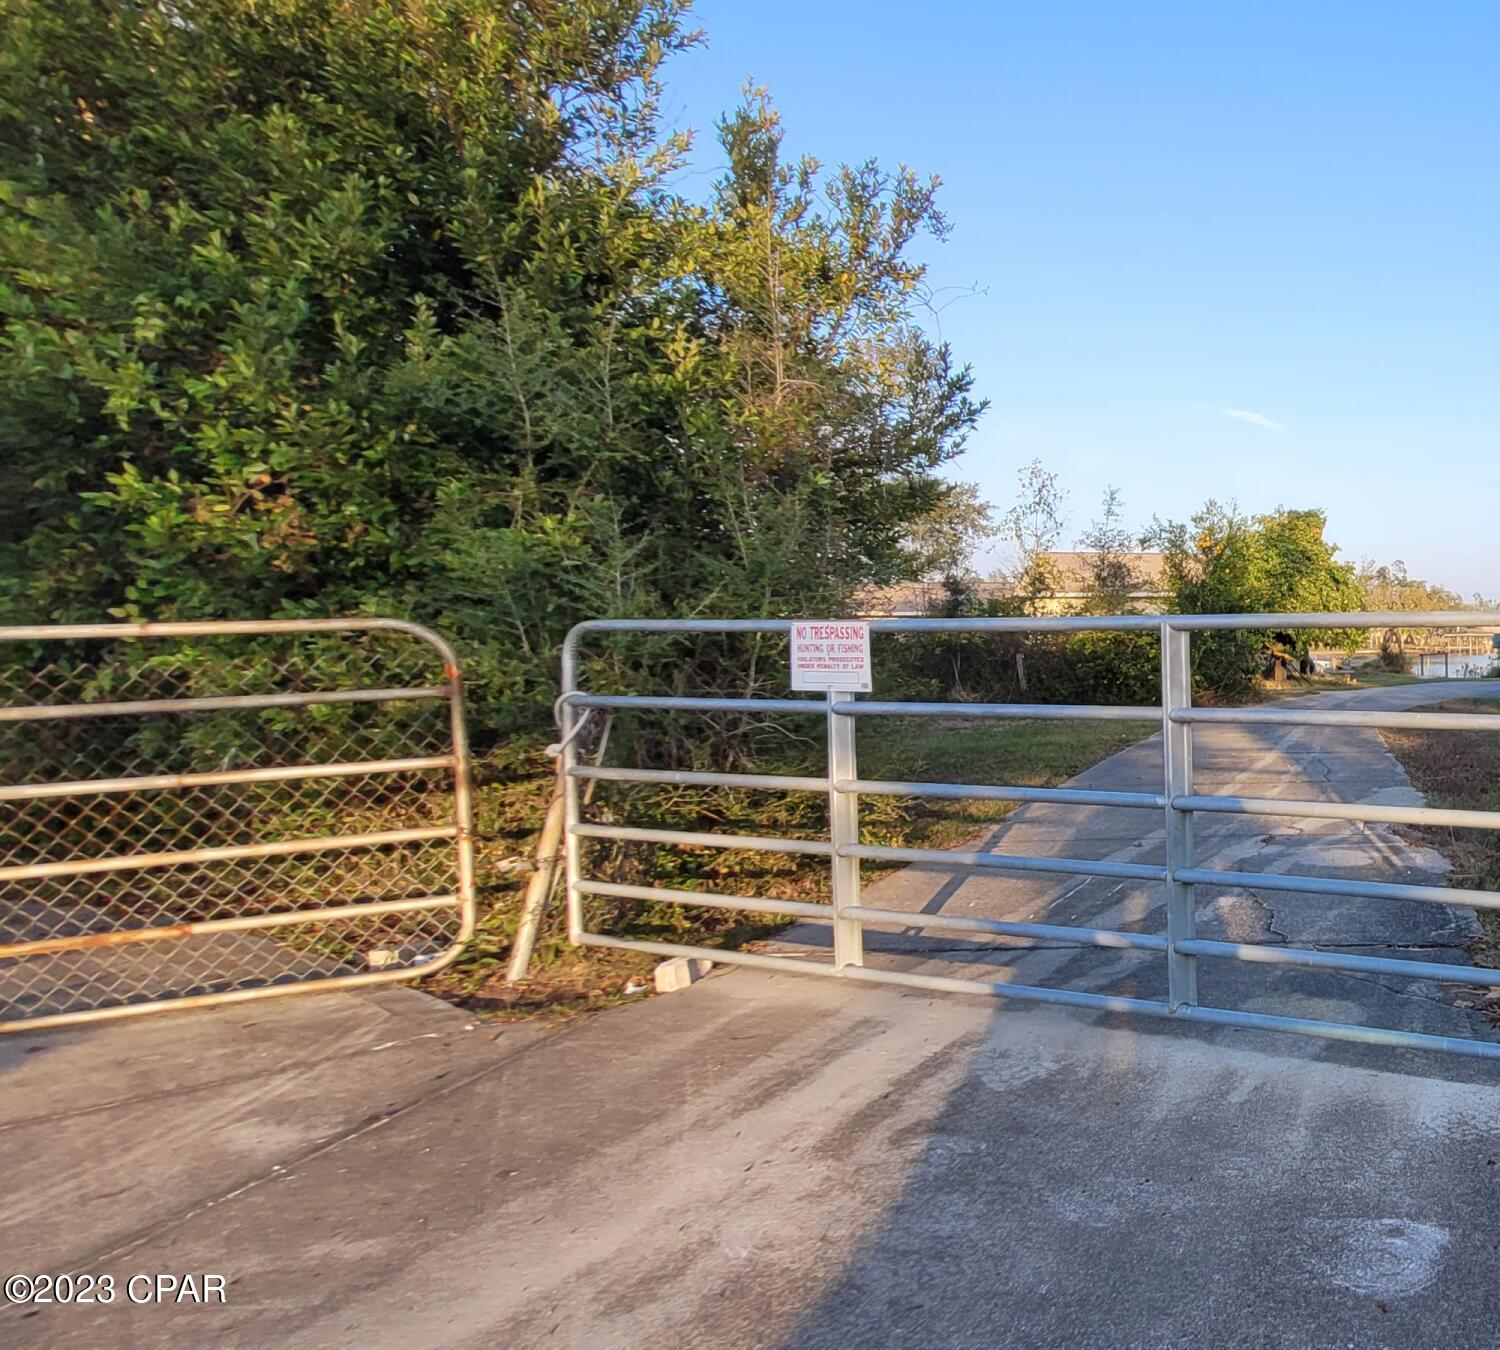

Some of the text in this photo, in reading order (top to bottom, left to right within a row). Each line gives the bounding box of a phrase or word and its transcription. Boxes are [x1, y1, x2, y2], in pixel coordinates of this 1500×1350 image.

[796, 626, 864, 640] NO TRESPASSING
[797, 643, 864, 653] HUNTING OR FISHING
